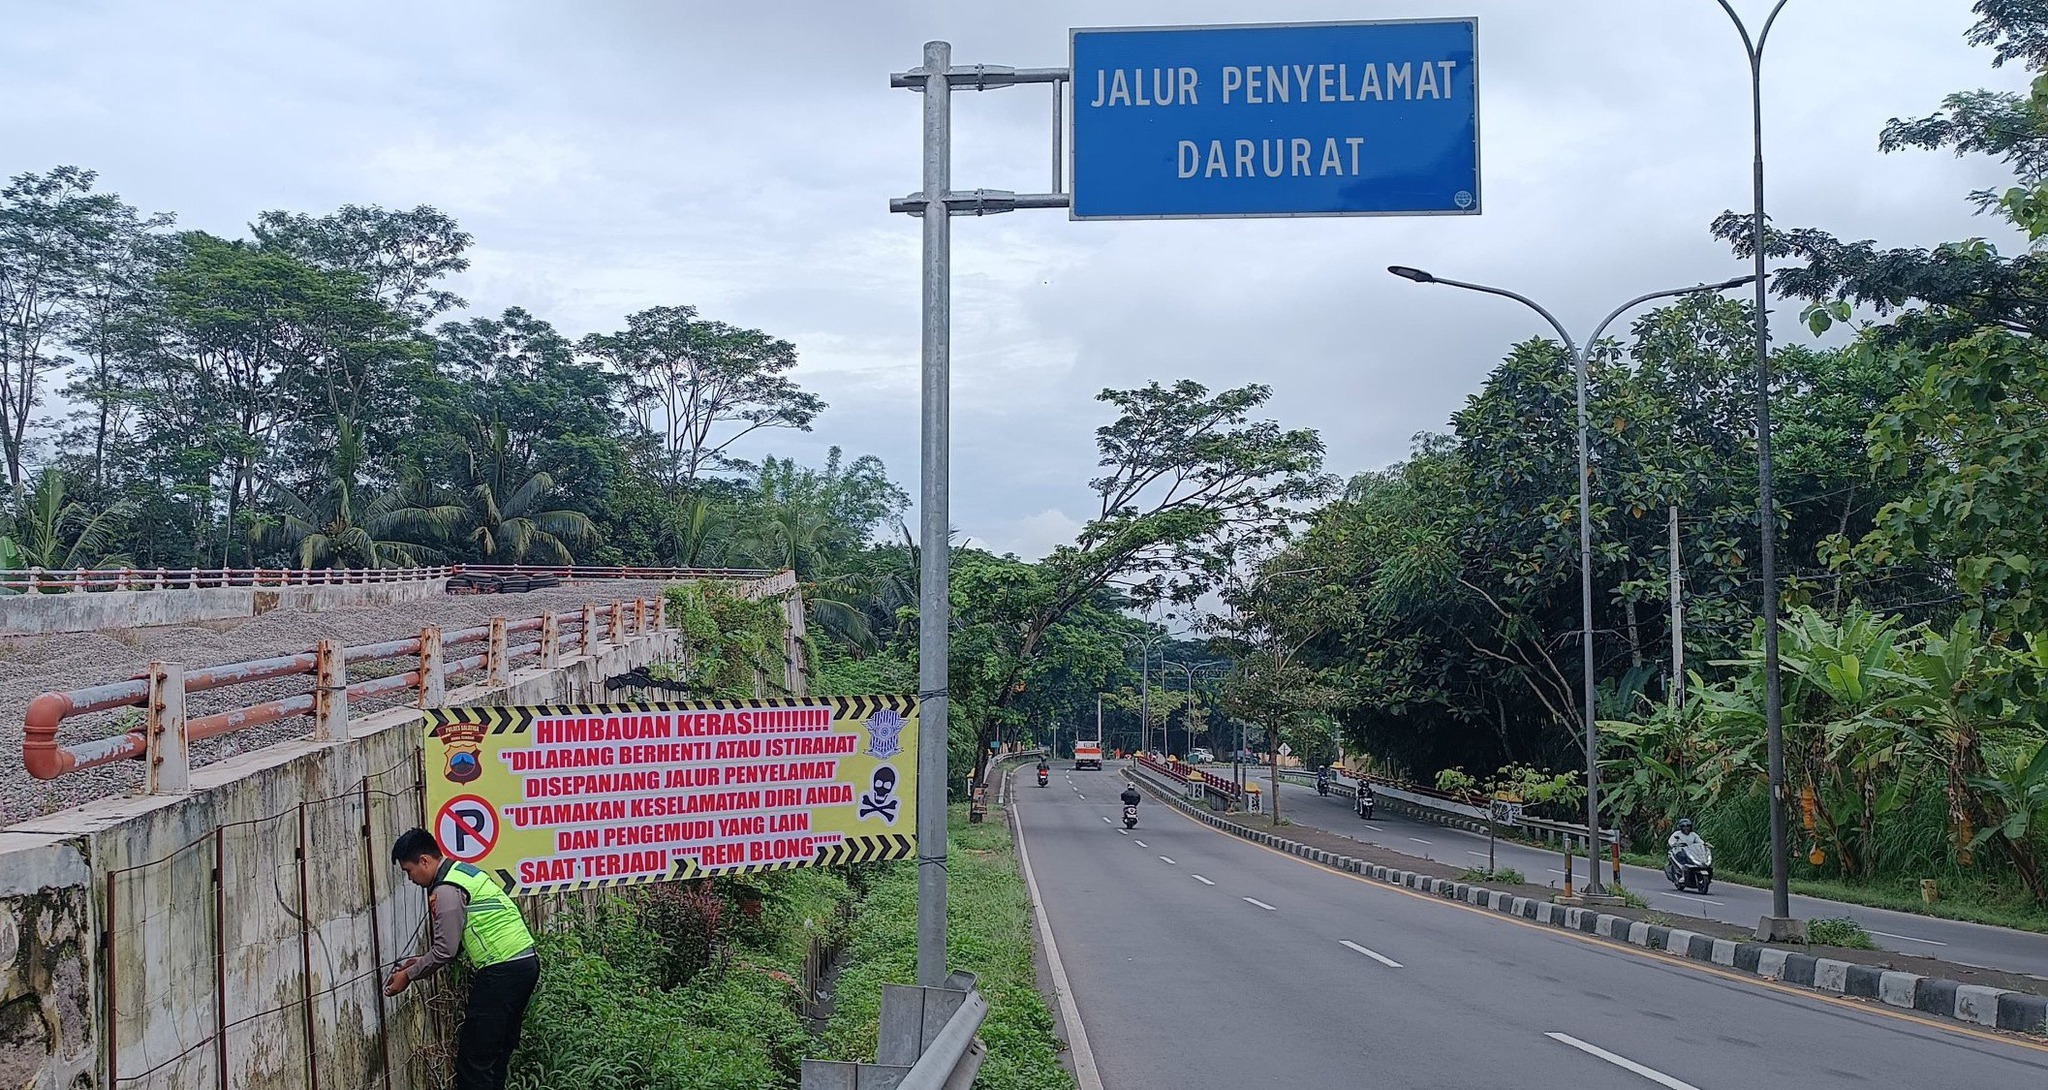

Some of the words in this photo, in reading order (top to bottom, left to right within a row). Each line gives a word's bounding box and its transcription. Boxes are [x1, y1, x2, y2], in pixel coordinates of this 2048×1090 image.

[1091, 67, 1199, 107] JALUR
[1222, 61, 1457, 104] PENYELAMAT
[1178, 137, 1364, 178] DARURAT
[536, 715, 671, 744] HIMBAUAN
[502, 746, 614, 771] "DILARANG
[619, 742, 711, 765] BERHENTI
[715, 739, 761, 759] ATAU
[765, 735, 857, 757] ISTIRAHAT
[526, 771, 660, 798] DISEPANJANG
[664, 768, 719, 788] JALUR
[725, 761, 836, 785] PENYELAMAT
[504, 800, 626, 827] "UTAMAKAN
[630, 791, 760, 818] KESELAMATAN
[764, 788, 802, 808] DIRI
[805, 785, 853, 805] ANDA
[558, 829, 599, 851] DAN
[603, 820, 714, 847] PENGEMUDI
[718, 816, 765, 837] YANG
[769, 813, 808, 833] LAIN
[520, 857, 577, 884] SAAT
[581, 850, 667, 877] TERJADI
